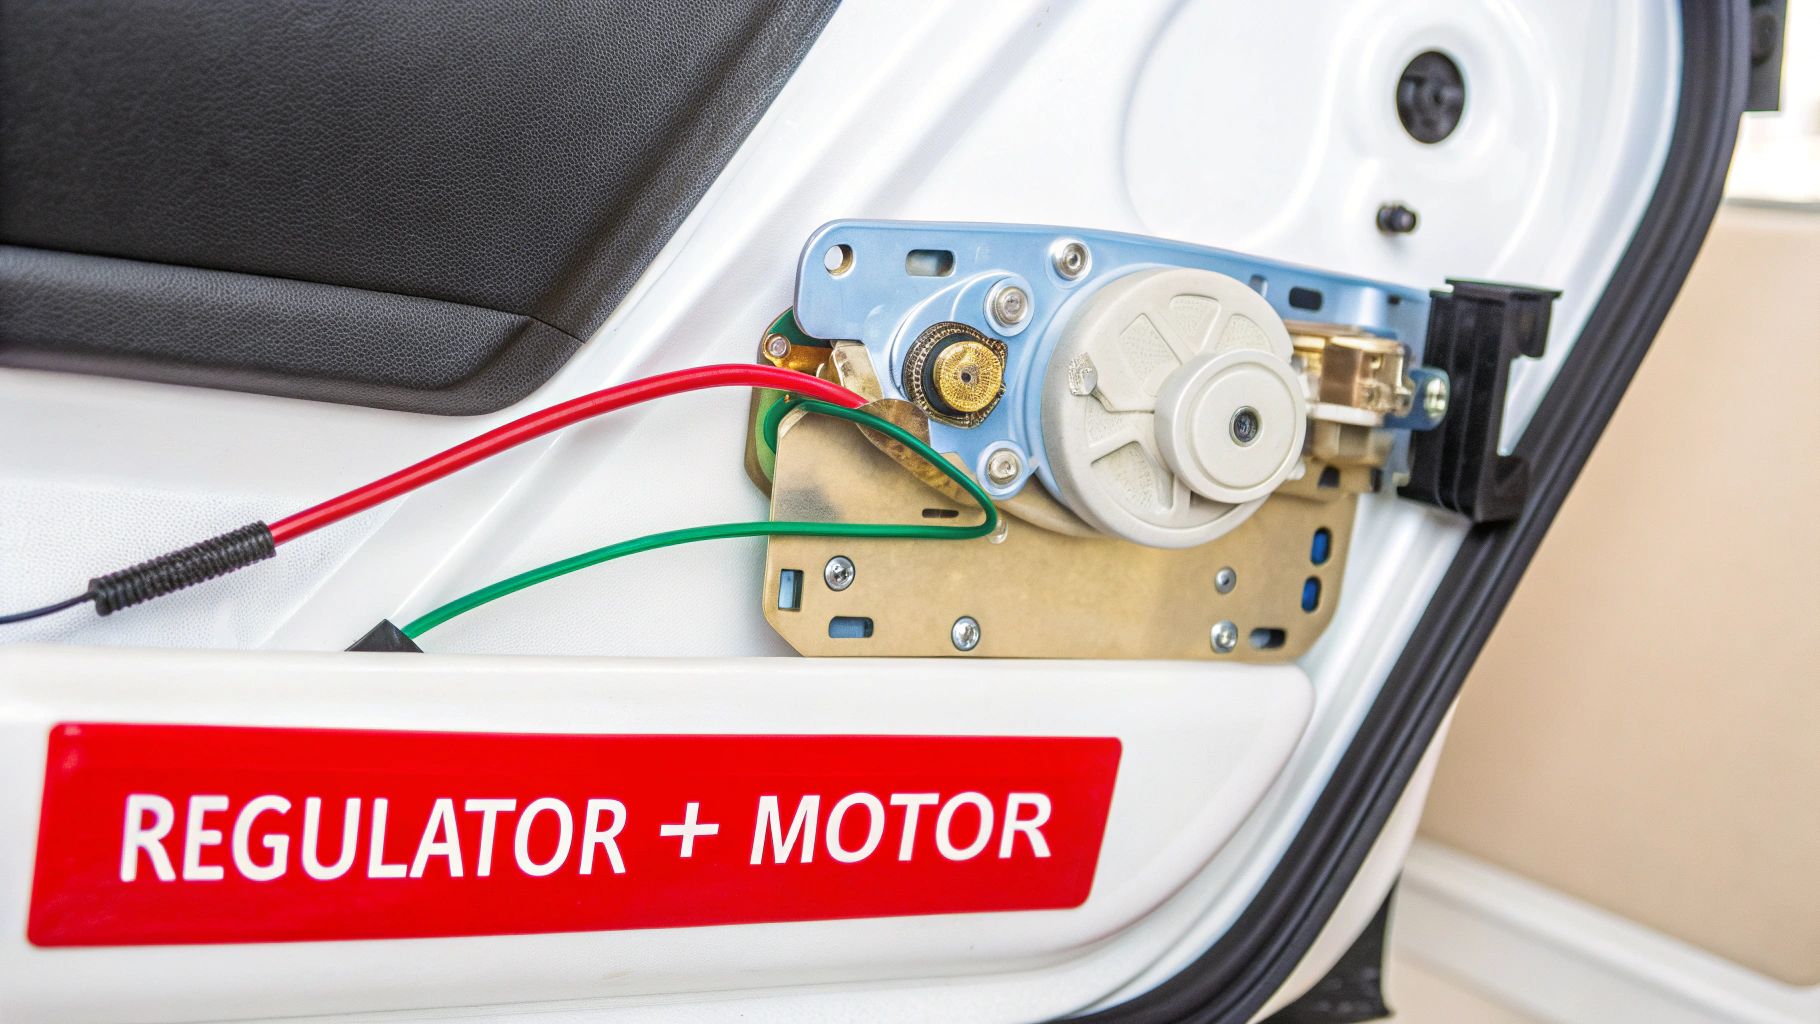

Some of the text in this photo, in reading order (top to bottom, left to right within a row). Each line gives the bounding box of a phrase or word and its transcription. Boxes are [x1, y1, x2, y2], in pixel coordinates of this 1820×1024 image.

[120, 791, 1052, 883] REGULATOR + MOTOR
